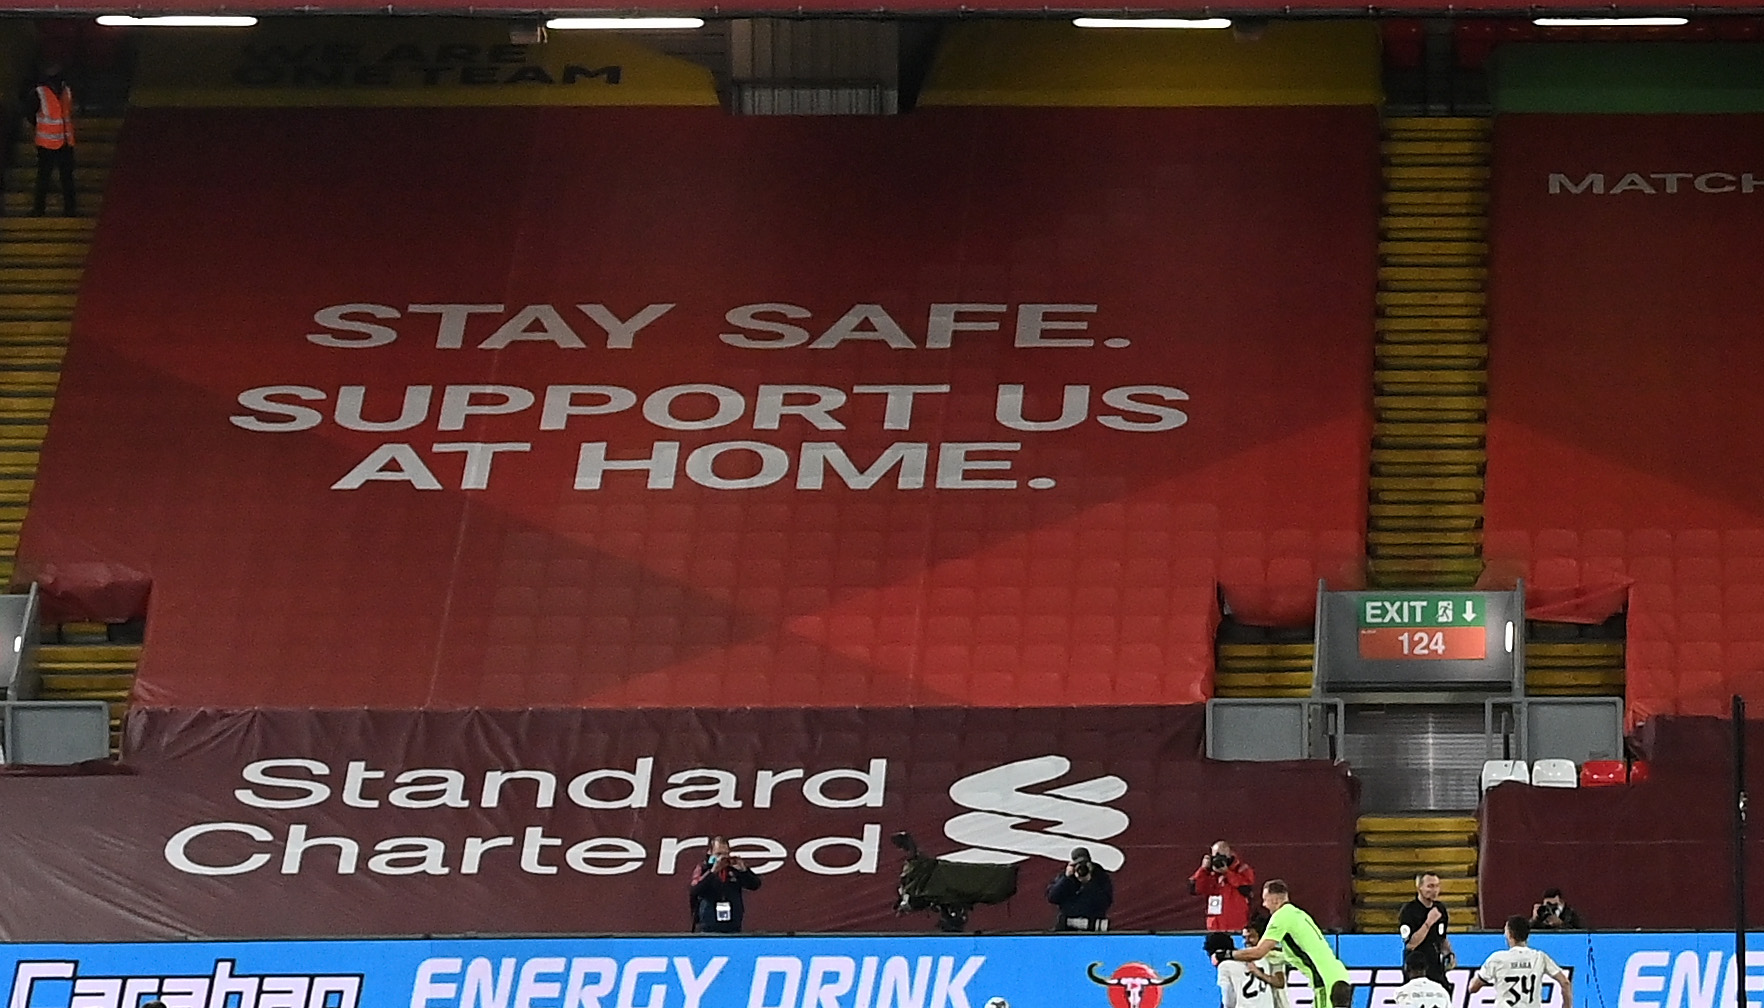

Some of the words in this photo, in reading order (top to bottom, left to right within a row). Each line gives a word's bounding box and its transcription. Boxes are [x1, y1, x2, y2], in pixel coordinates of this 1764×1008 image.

[306, 303, 676, 350] STAY
[718, 303, 1131, 350] SAFE.
[229, 383, 951, 432] SUPPORT
[994, 383, 1190, 432] US
[330, 441, 531, 491] AT
[573, 441, 1056, 491] HOME.
[1365, 600, 1428, 623] EXIT
[1398, 631, 1446, 655] 124
[233, 756, 887, 810] Standard
[163, 822, 881, 877] Chartered
[1504, 973, 1536, 1007] 34
